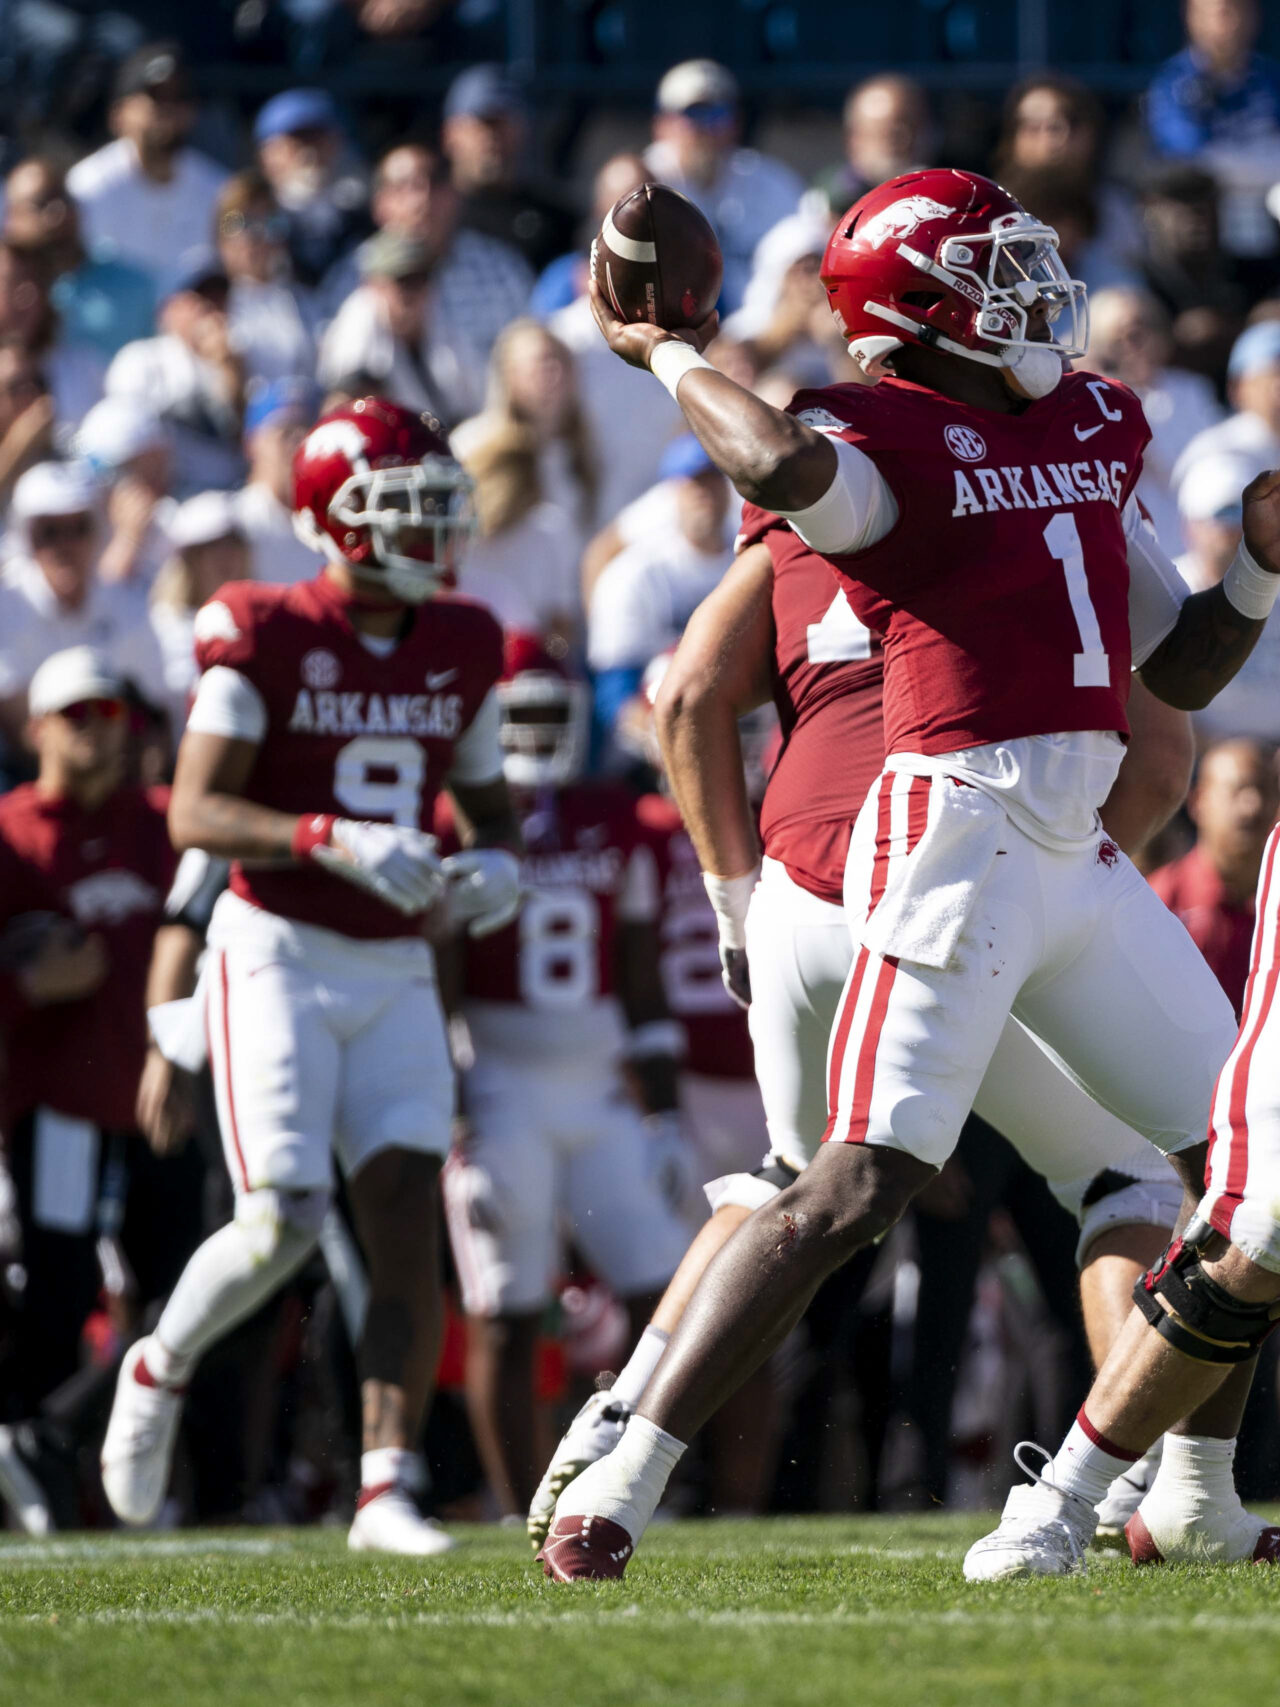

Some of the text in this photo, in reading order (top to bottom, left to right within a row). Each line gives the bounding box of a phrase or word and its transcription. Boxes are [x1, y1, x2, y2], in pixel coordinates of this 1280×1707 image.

[1086, 380, 1123, 422] C
[948, 426, 984, 459] SEC
[952, 459, 1127, 518] ARKANSAS
[1042, 511, 1111, 688] 1
[289, 687, 463, 739] ARKANSAS
[334, 735, 427, 828] 9
[518, 887, 601, 1006] 8
